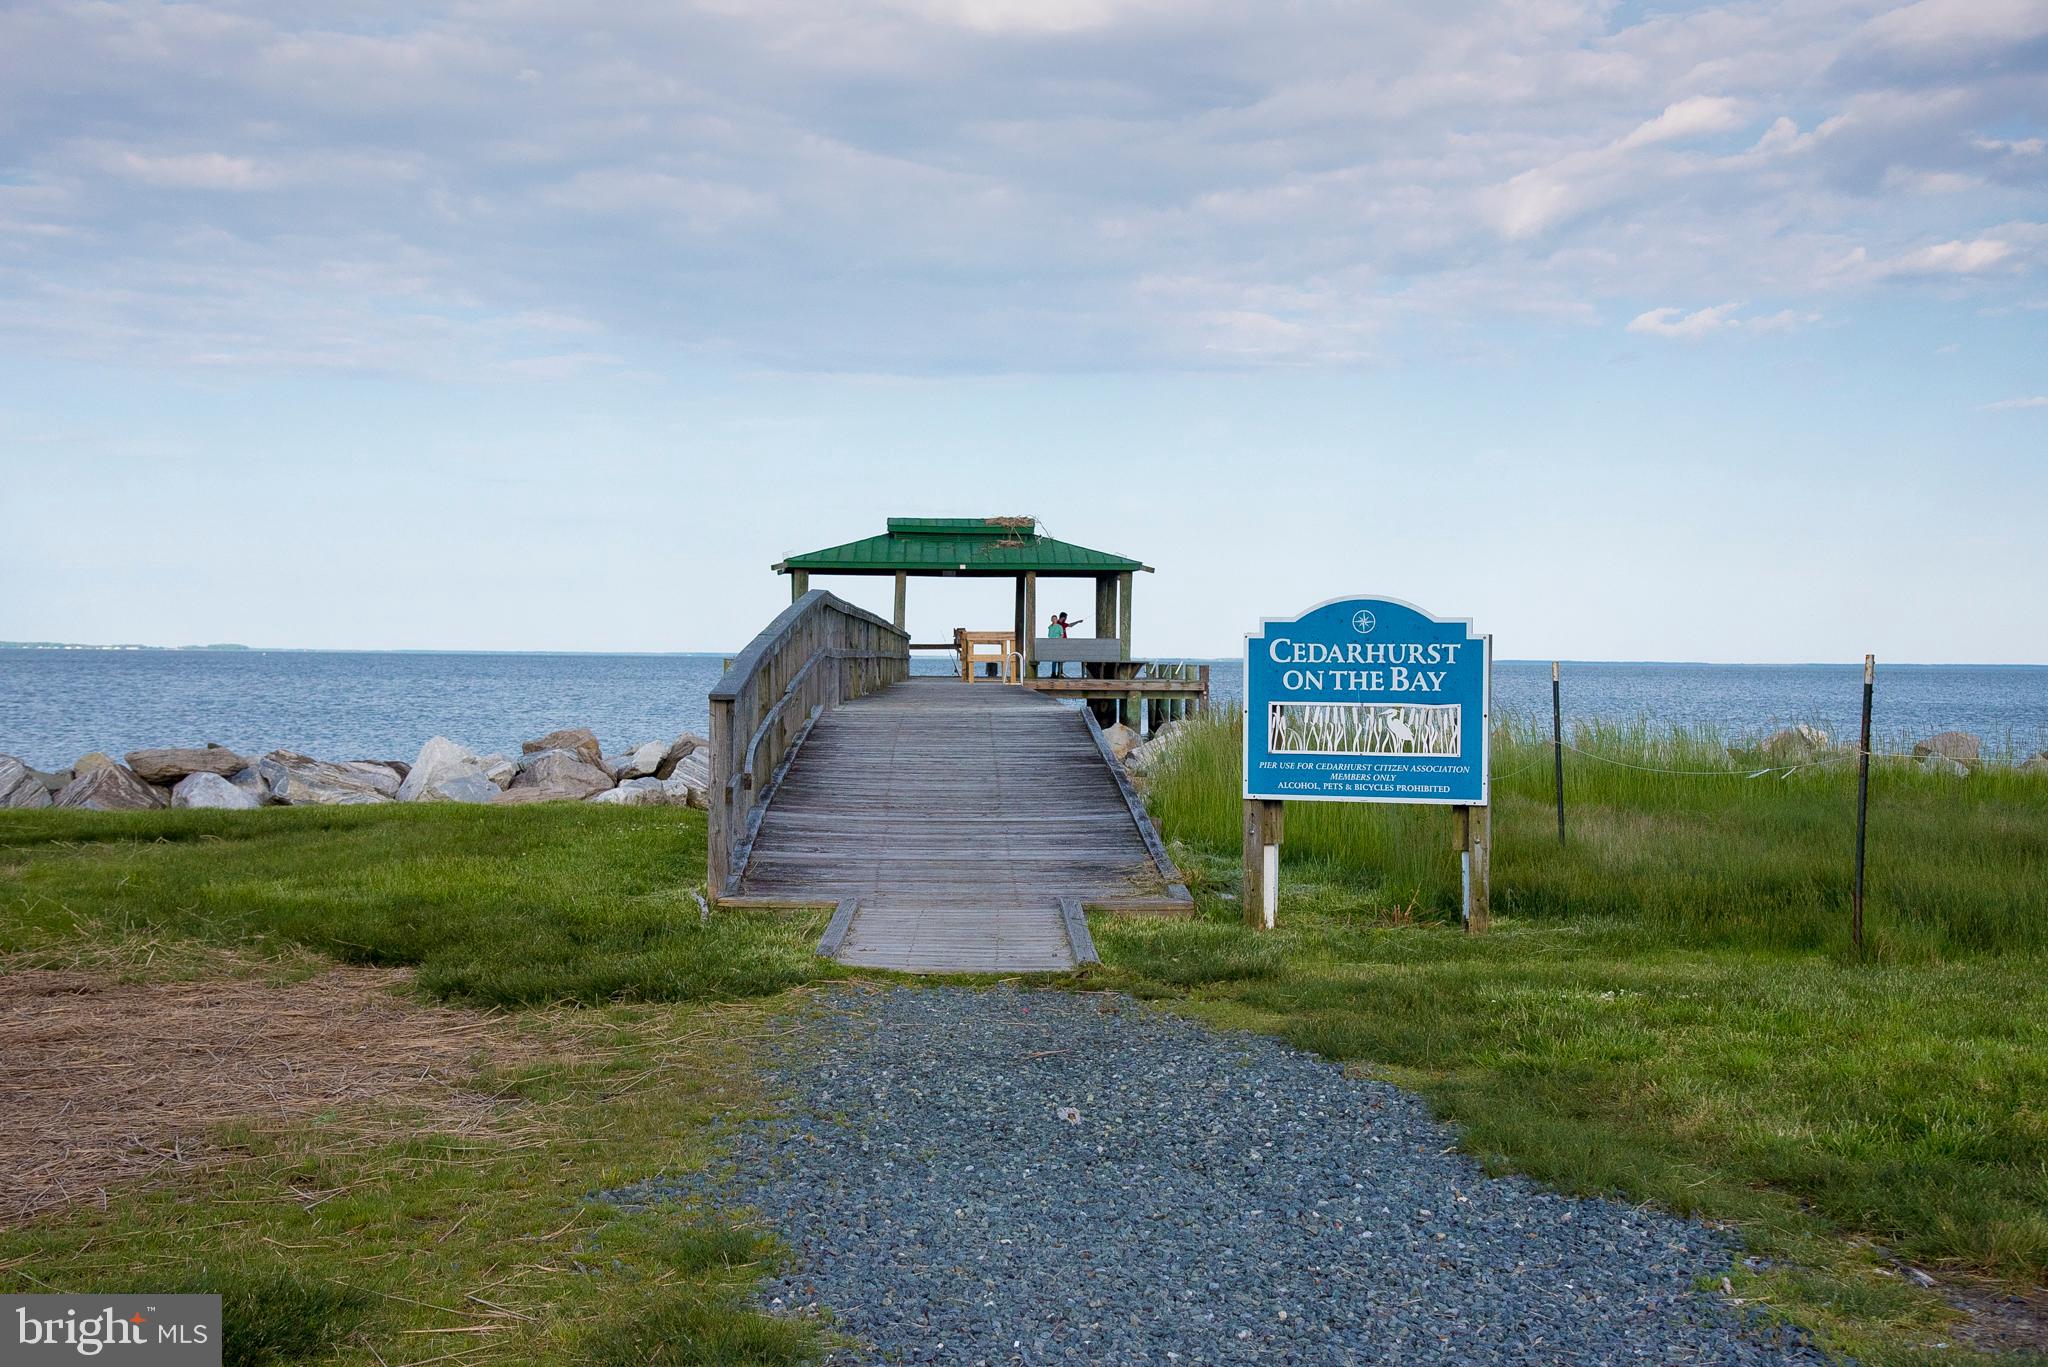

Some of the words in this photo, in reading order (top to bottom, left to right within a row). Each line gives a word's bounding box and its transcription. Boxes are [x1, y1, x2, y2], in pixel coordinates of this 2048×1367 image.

[1269, 638, 1461, 665] CEDARHURST
[1283, 670, 1324, 691] ON
[1329, 670, 1384, 691] THE
[1390, 667, 1447, 692] BAY
[1259, 761, 1278, 769] PIER
[1279, 762, 1296, 770] USE
[1296, 762, 1314, 770] FOR
[1315, 763, 1373, 772] CEDARHURST
[1374, 764, 1409, 772] CITIZEN
[1410, 765, 1470, 773] ASSOCIATION
[1330, 773, 1371, 781] MEMBERS
[1372, 774, 1397, 782] ONLY
[1278, 782, 1321, 791] ALCOHOL,
[1323, 783, 1343, 791] PETS
[1345, 783, 1352, 791] &
[1354, 783, 1394, 792] BICYCLES
[1396, 784, 1450, 793] PROHIBITED
